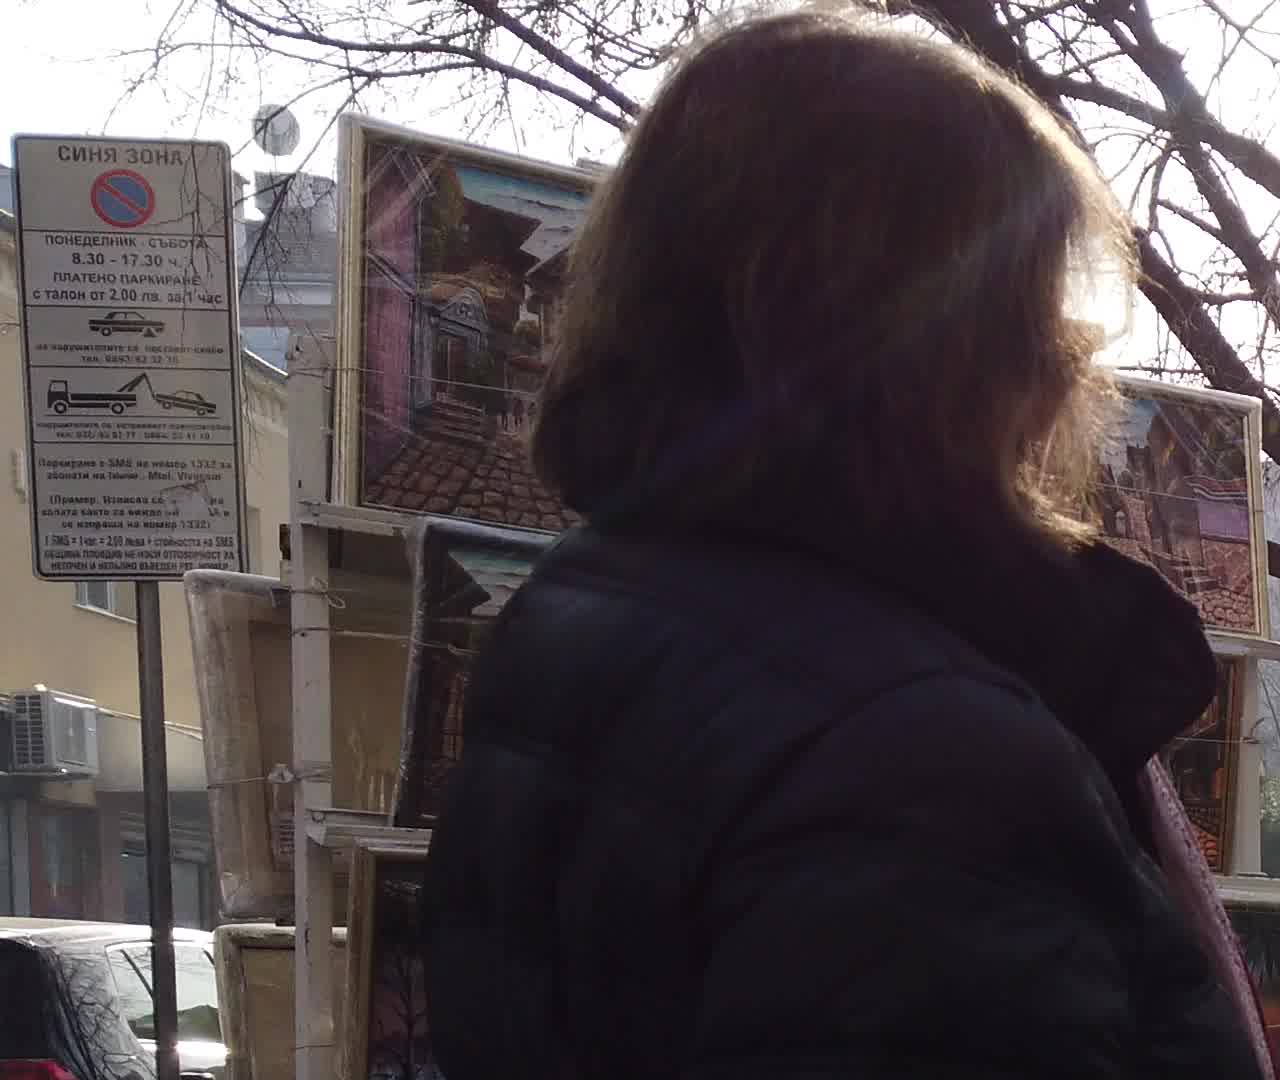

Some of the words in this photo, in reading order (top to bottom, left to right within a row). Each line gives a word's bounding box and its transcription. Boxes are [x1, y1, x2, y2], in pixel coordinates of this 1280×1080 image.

[58, 144, 117, 163] СИНЯ
[127, 148, 184, 166] ЗОНА
[45, 234, 137, 248] ПОНЕДЕЛНИК
[148, 238, 205, 249] СЪБОТА
[71, 252, 104, 265] 8.30
[121, 254, 163, 267] 17.30
[53, 272, 116, 284] ПЛАТЕНО
[120, 274, 201, 286] ПАРКИРАНЕ
[44, 289, 85, 301] талон
[90, 290, 105, 301] от
